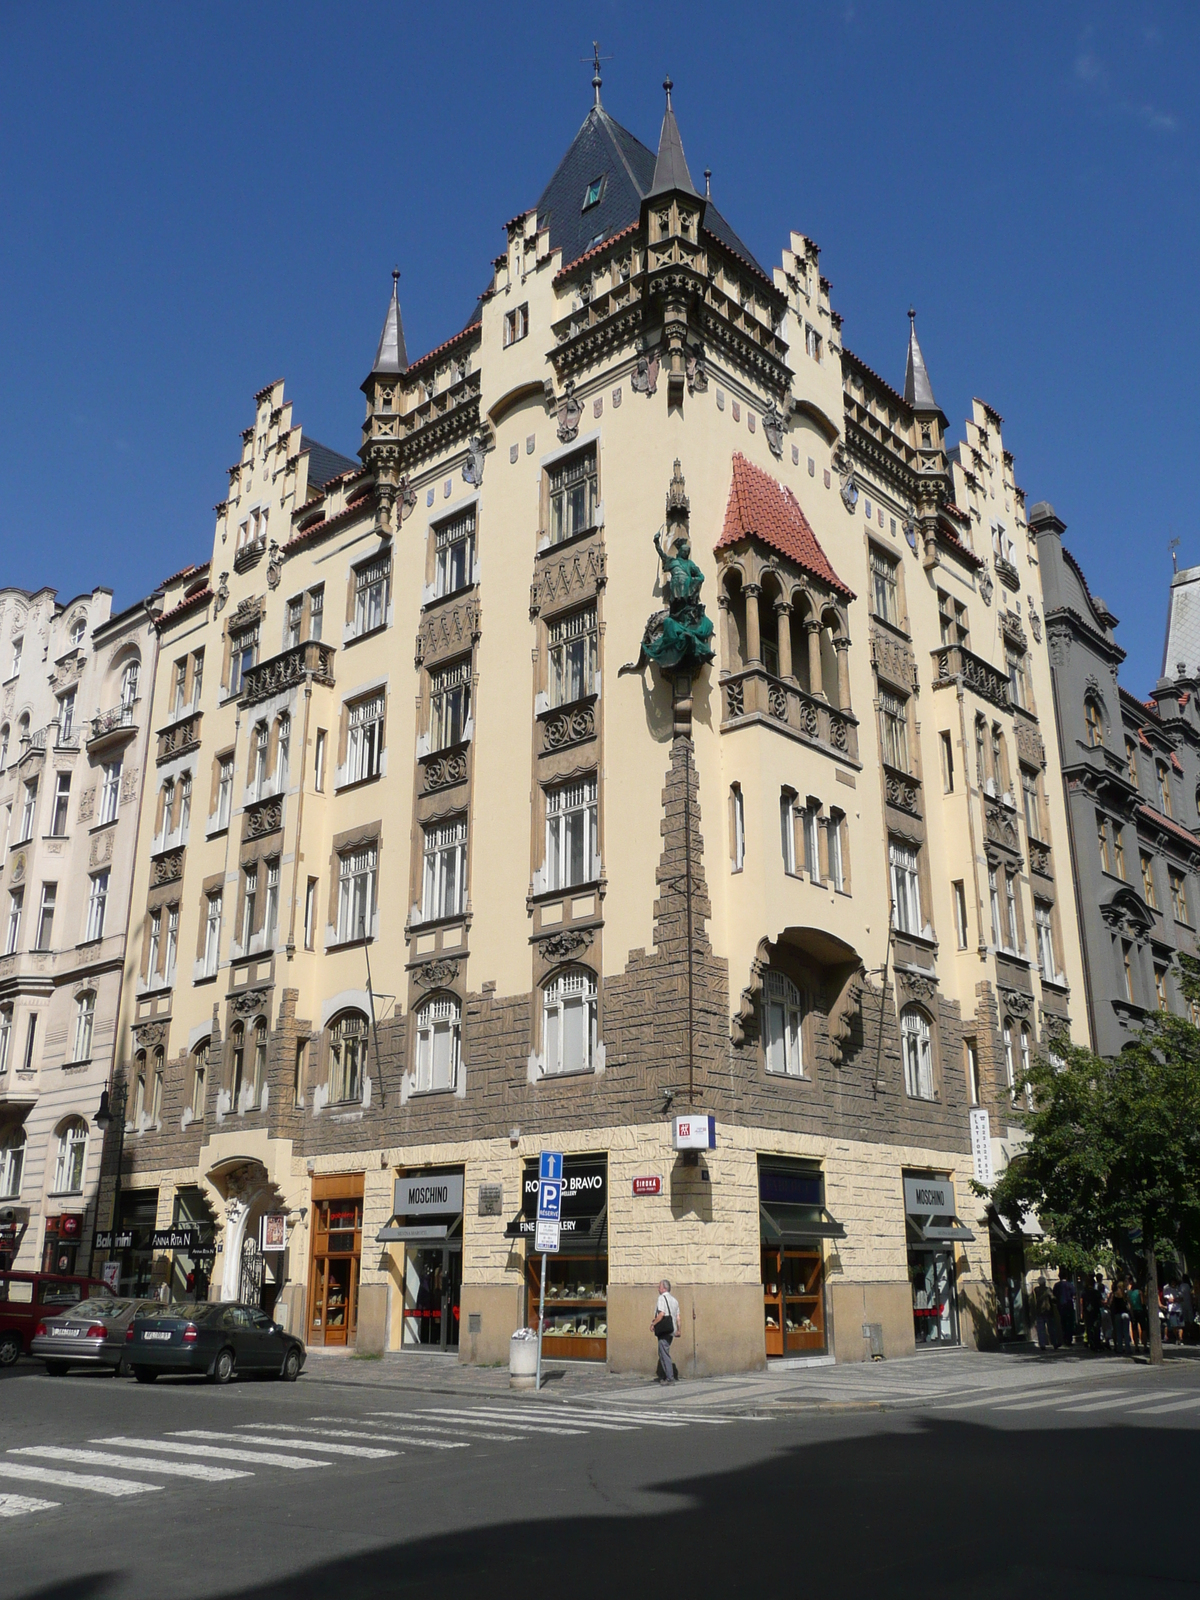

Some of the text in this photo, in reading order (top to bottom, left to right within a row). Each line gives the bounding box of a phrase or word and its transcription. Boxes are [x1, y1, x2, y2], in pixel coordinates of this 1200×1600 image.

[570, 1175, 602, 1190] BRAVO
[408, 1186, 448, 1204] MOSCHINO
[543, 1185, 557, 1208] P
[916, 1188, 945, 1206] MOSCHINO
[520, 1222, 535, 1232] FINE
[152, 1233, 190, 1246] ANNA RITA N
